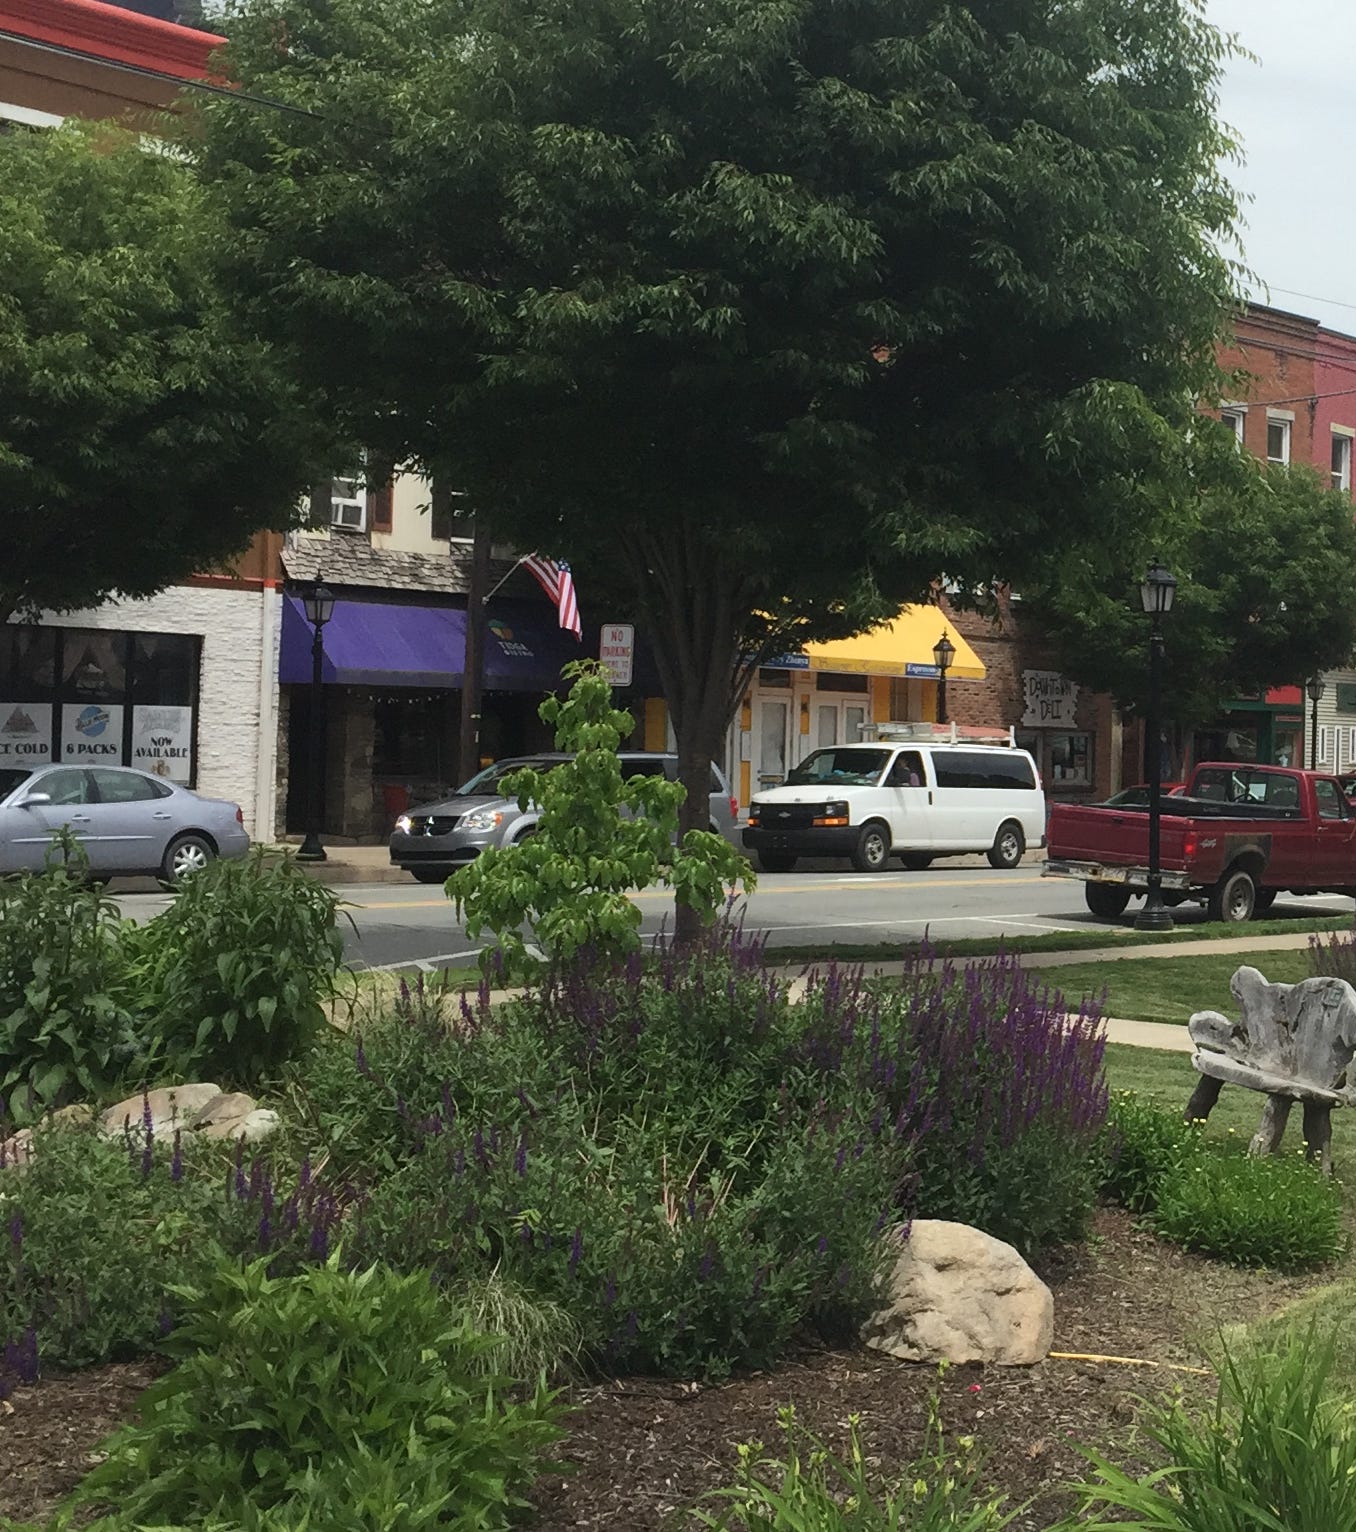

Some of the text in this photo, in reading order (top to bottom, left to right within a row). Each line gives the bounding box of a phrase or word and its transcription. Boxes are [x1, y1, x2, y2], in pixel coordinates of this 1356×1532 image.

[611, 630, 624, 642] NO
[1040, 699, 1063, 721] DELI
[150, 737, 173, 747] NOW
[15, 743, 49, 754] COLD
[66, 743, 117, 755] 6 PACKS
[134, 748, 188, 758] AVAILABLE
